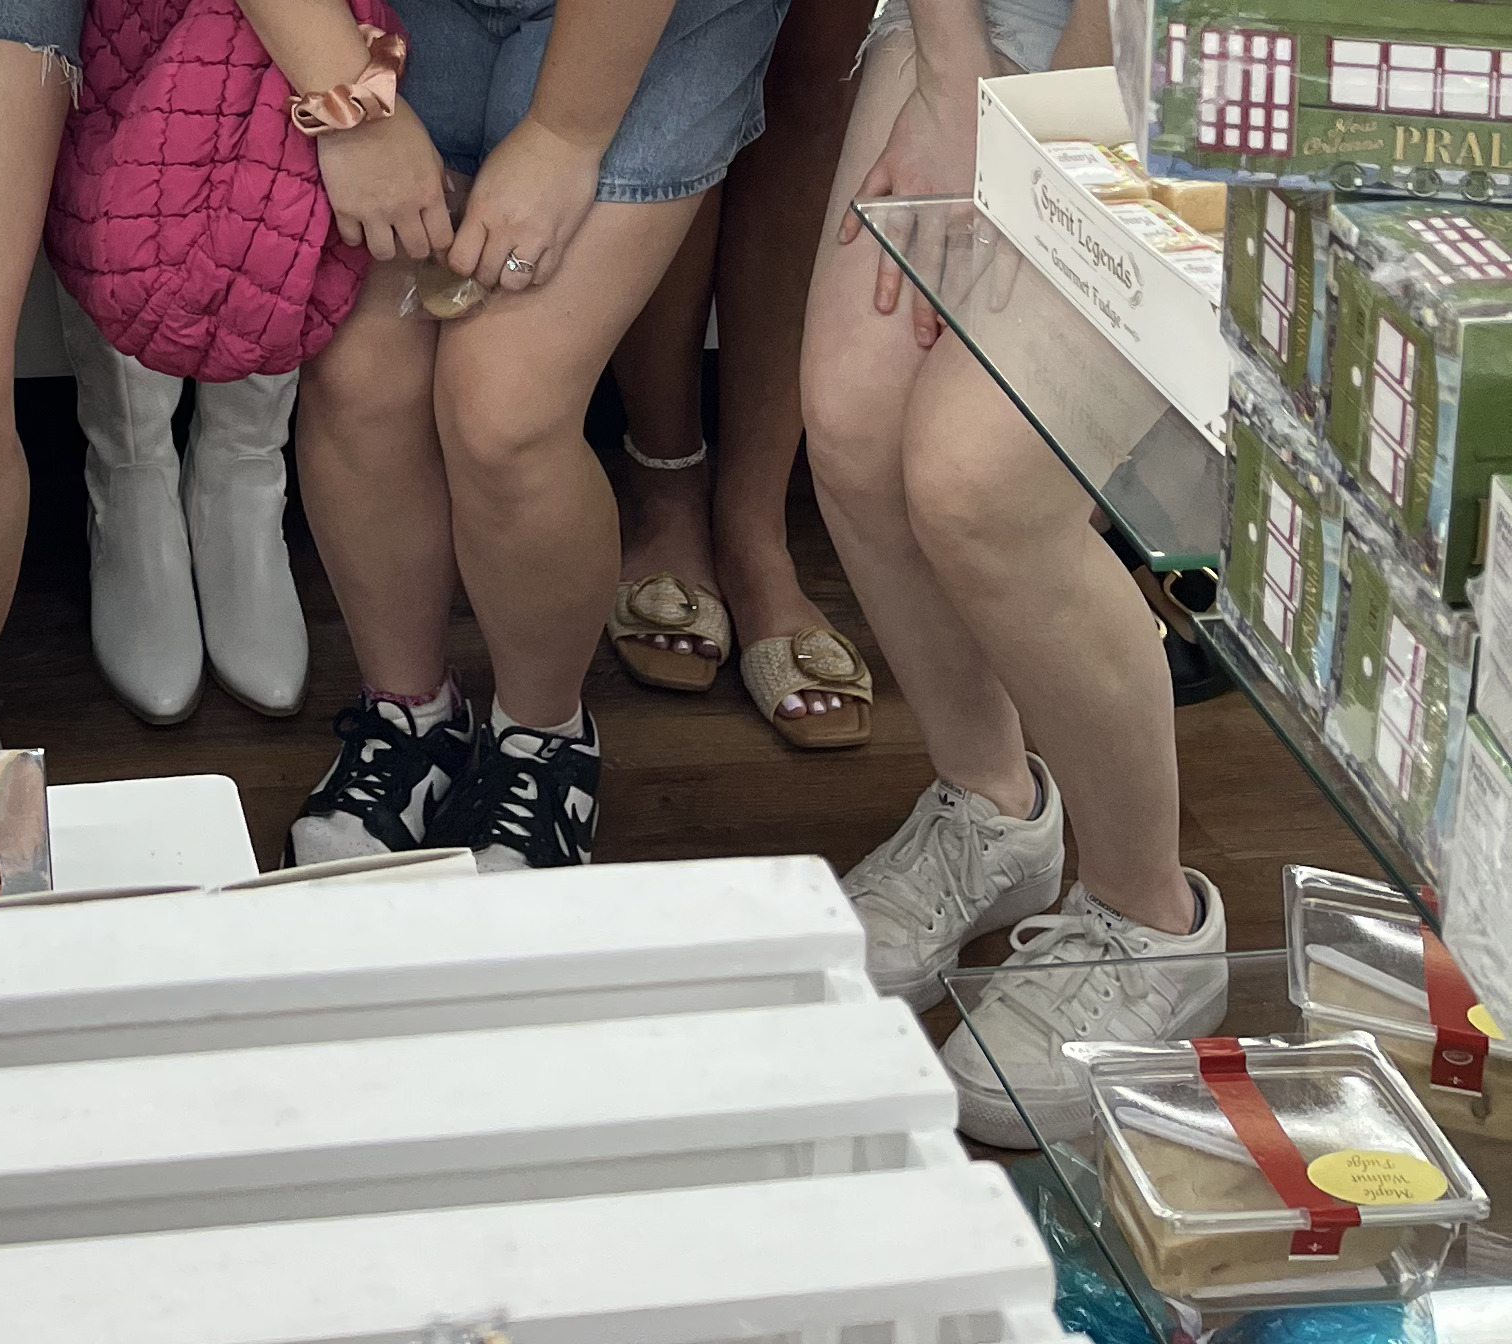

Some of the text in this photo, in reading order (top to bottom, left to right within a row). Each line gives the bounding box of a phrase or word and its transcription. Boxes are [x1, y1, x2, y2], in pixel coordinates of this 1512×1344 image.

[1041, 184, 1133, 290] Spirit Legends
[1051, 247, 1122, 329] Gourmet Fudge
[1346, 1154, 1397, 1172] Fudge
[1350, 1173, 1412, 1187] Walnut
[1363, 1184, 1414, 1201] Maple
